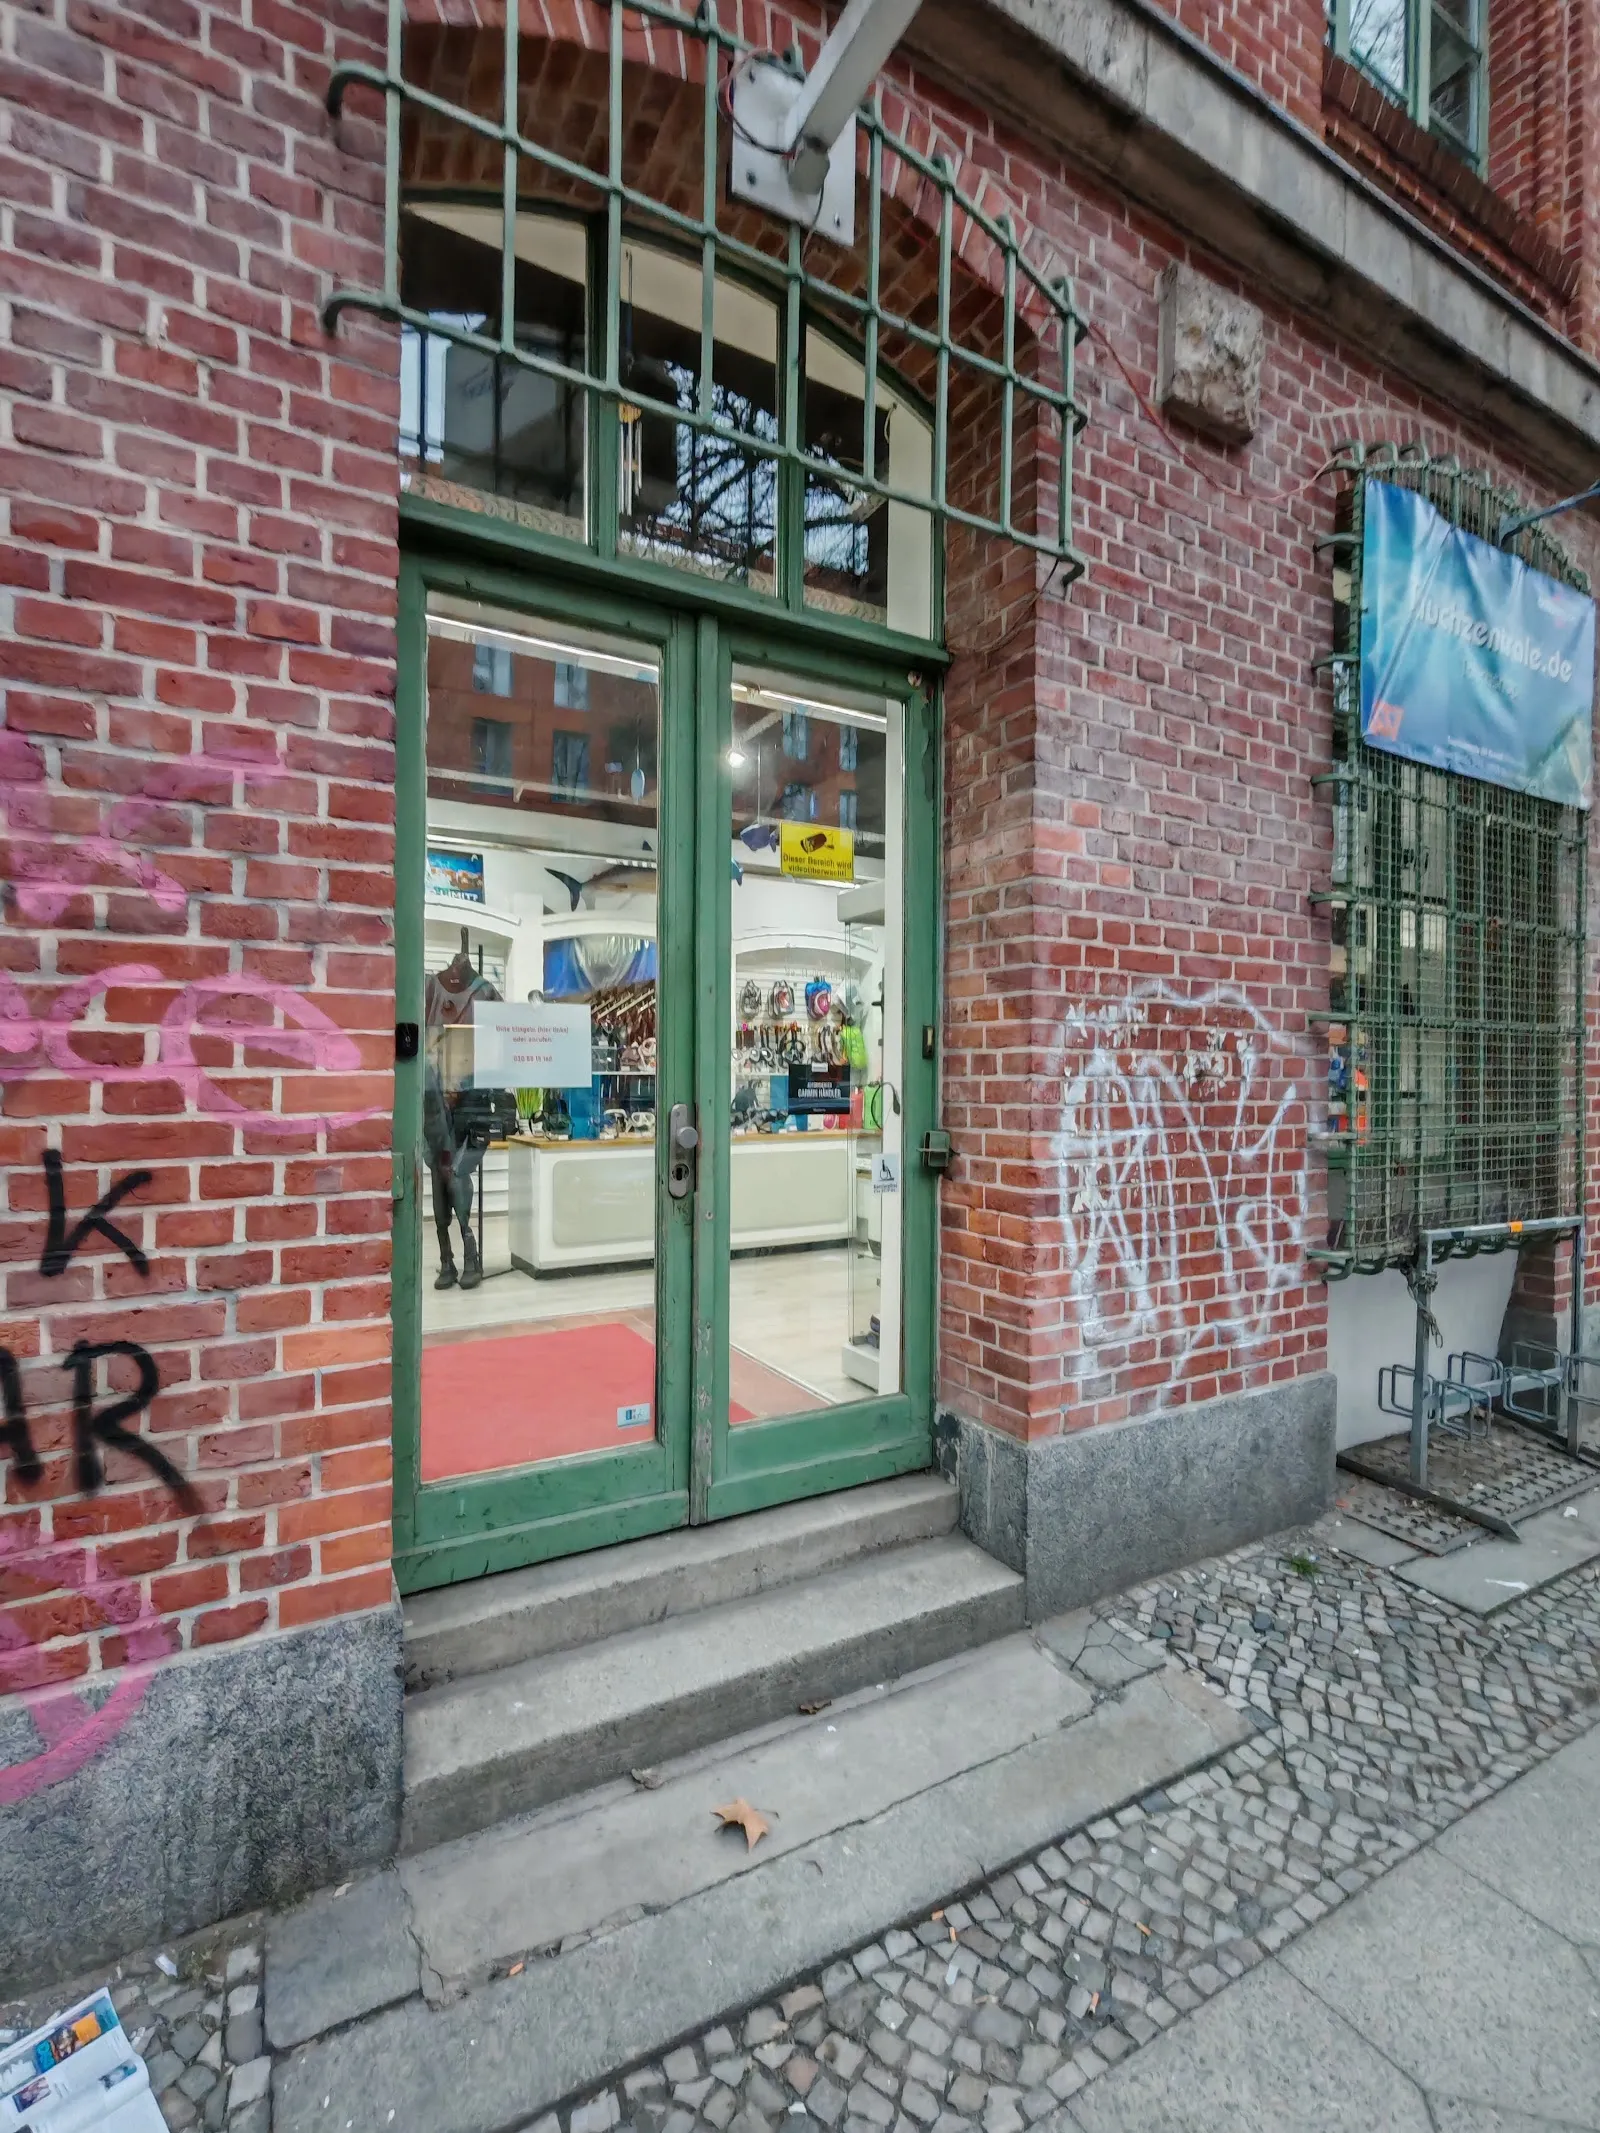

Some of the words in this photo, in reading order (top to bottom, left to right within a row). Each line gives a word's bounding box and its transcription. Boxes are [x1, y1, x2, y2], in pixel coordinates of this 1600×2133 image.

[783, 853, 806, 864] Dieser
[808, 857, 834, 868] Bereich
[837, 861, 852, 870] wird
[41, 1148, 152, 1278] K
